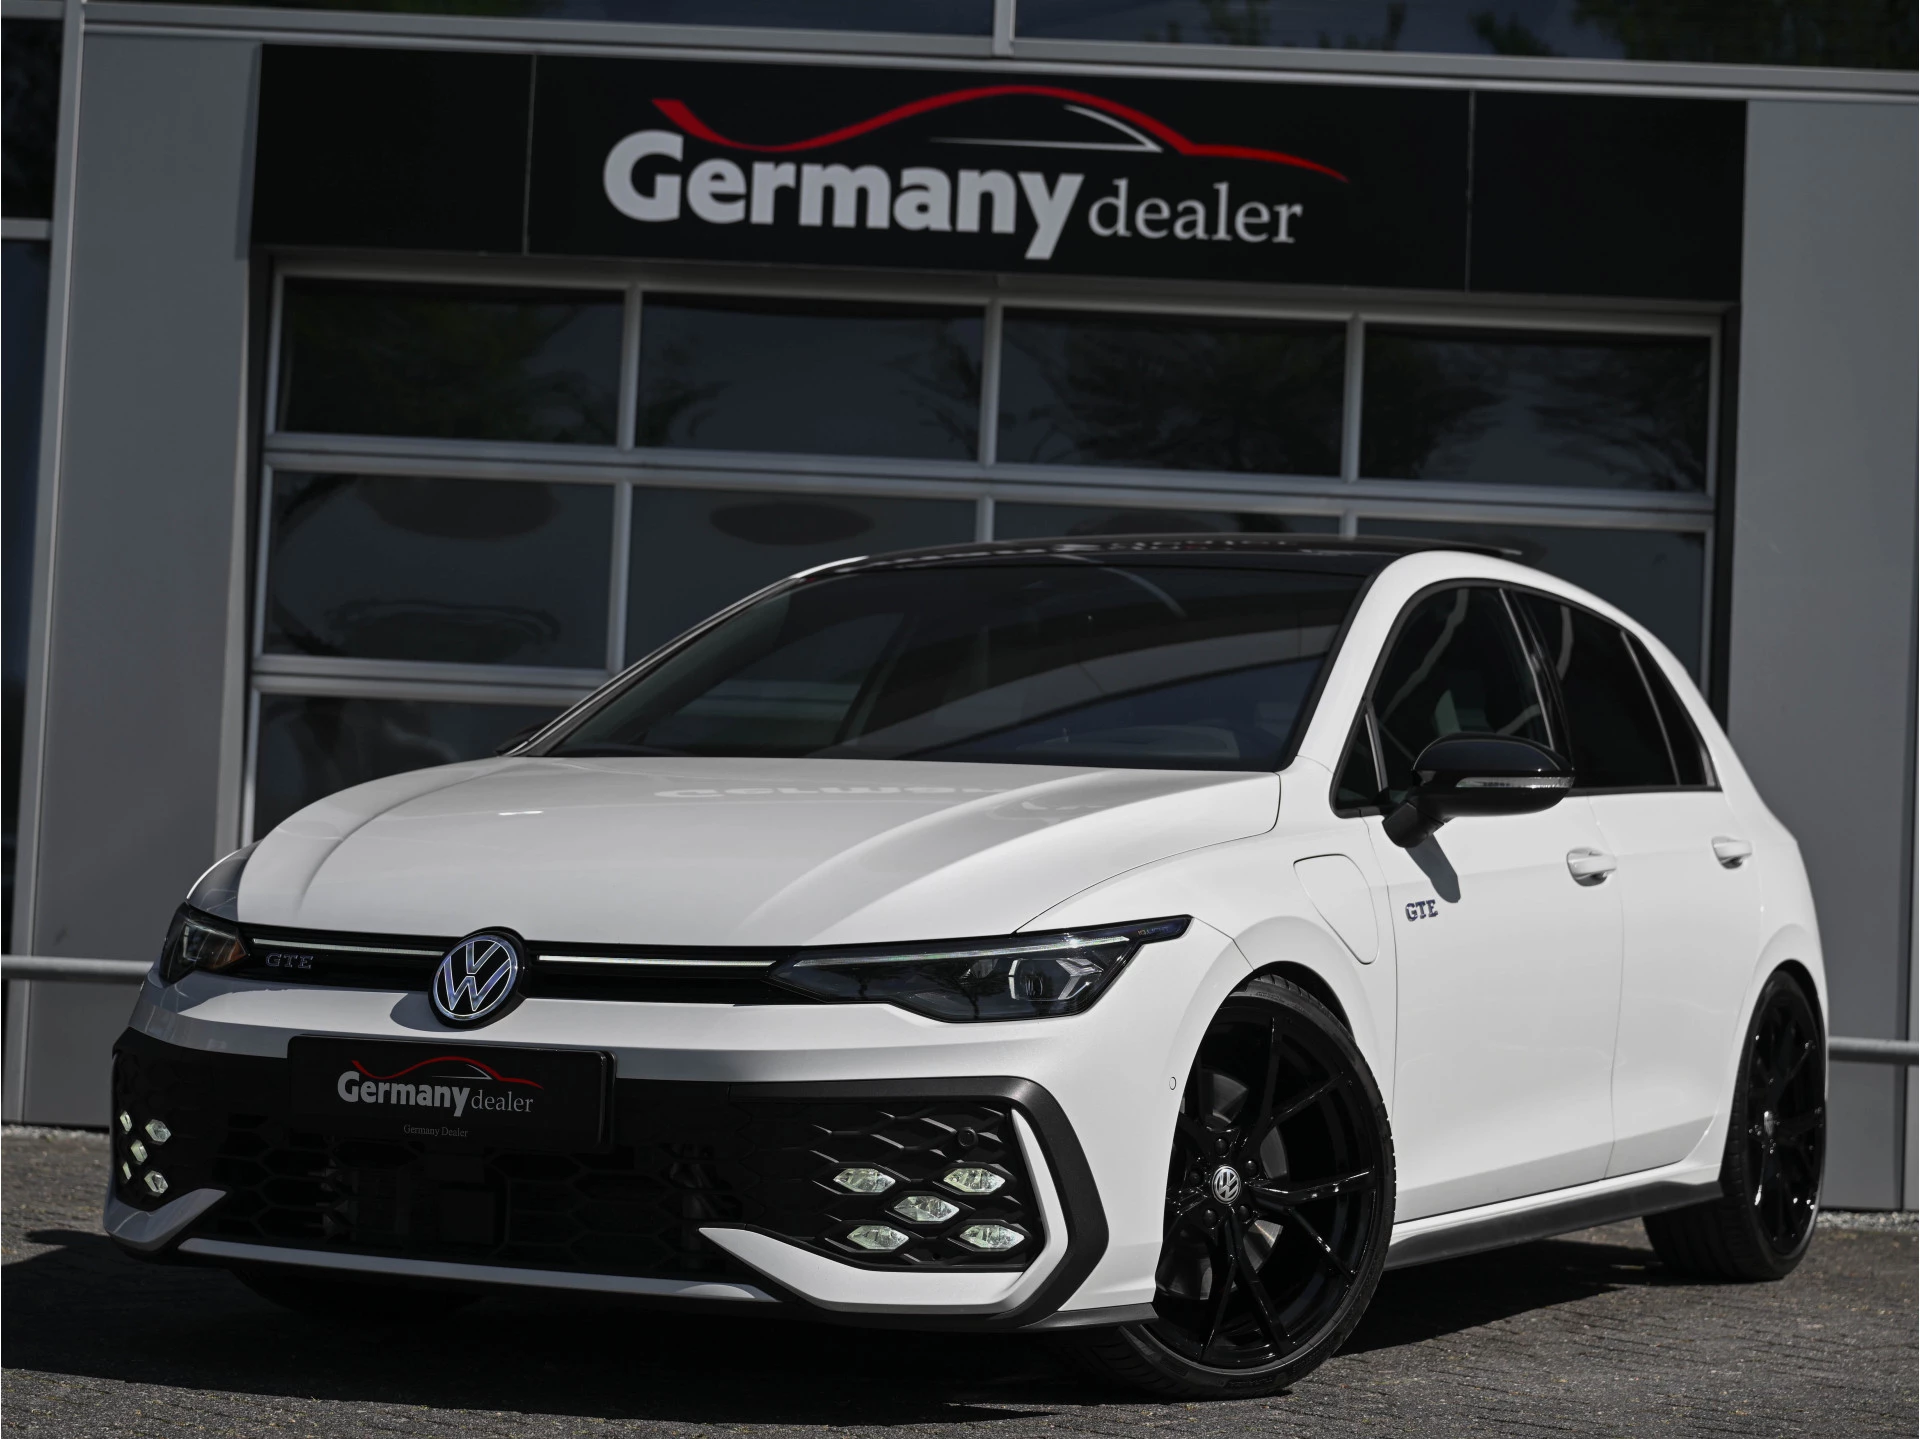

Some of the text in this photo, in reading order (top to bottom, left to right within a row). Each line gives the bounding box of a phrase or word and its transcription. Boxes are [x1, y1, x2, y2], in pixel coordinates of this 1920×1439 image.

[603, 129, 1303, 260] Germany dealer
[1405, 899, 1439, 922] GTE
[266, 952, 314, 970] GTE
[437, 936, 514, 1017] VW
[337, 1070, 534, 1117] Germany dealer
[403, 1124, 468, 1137] Germany Dealer
